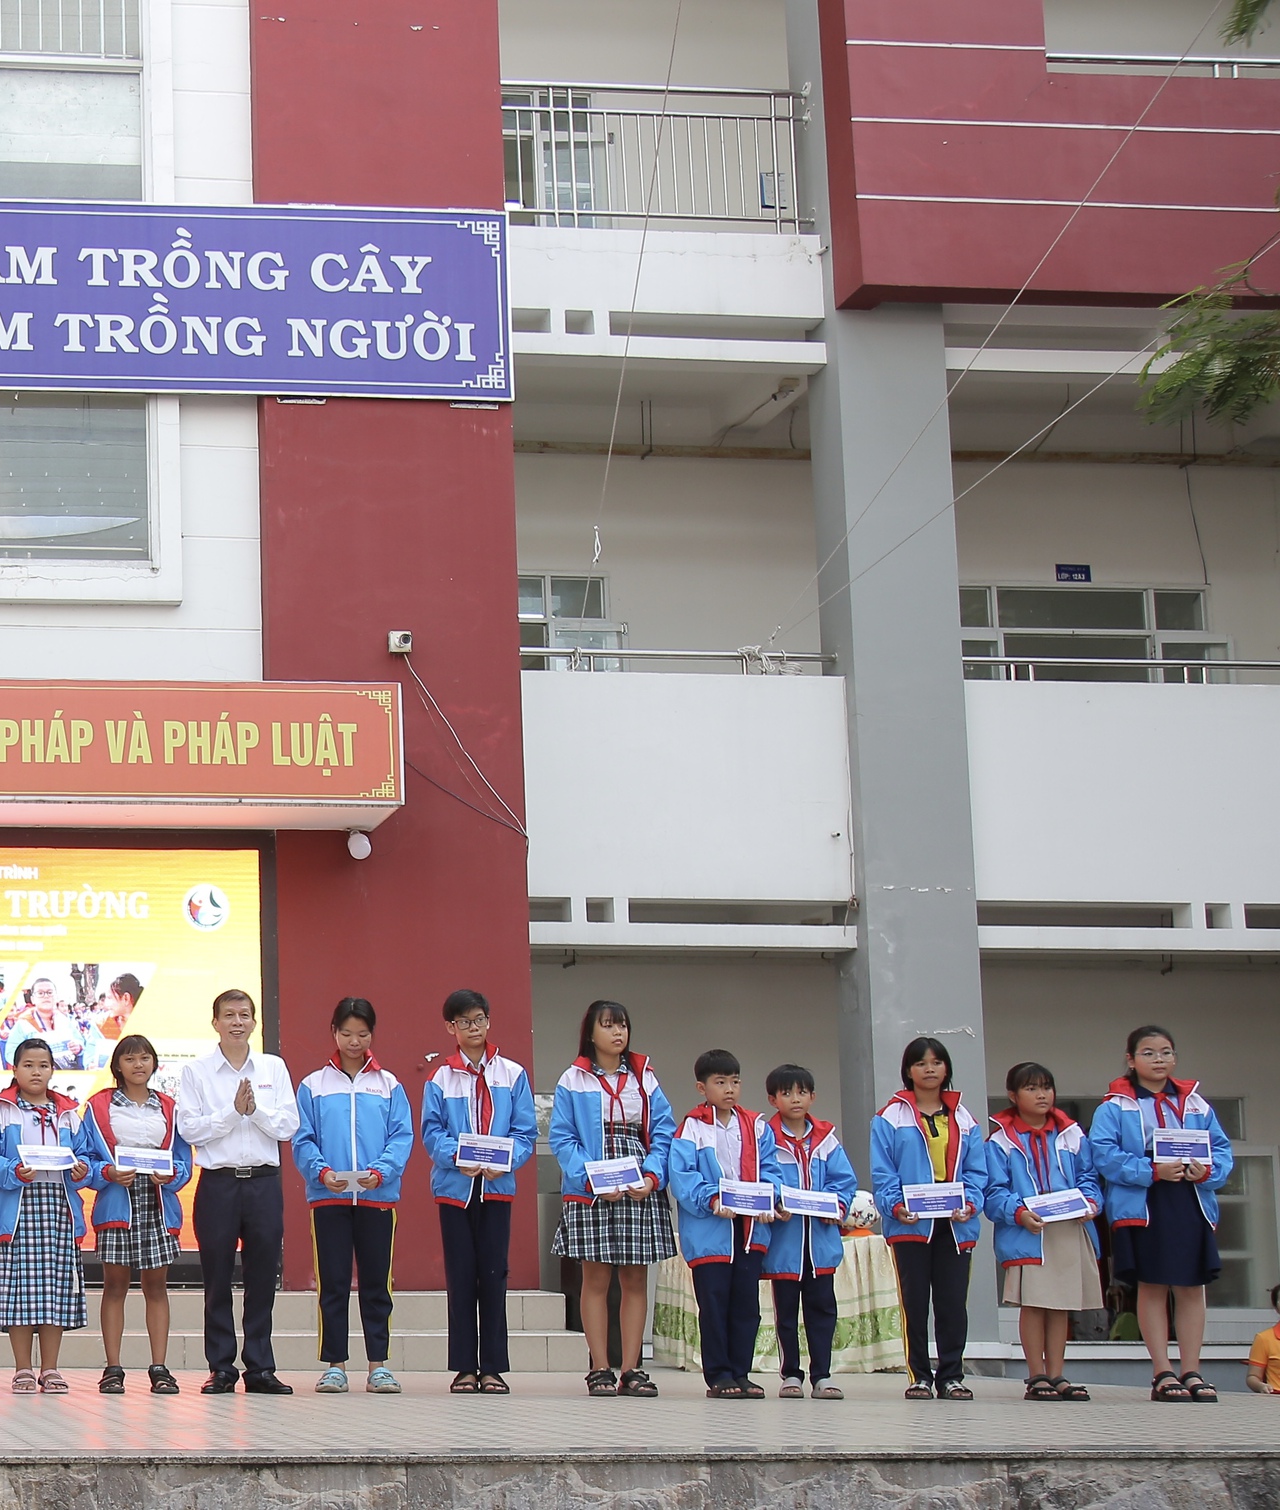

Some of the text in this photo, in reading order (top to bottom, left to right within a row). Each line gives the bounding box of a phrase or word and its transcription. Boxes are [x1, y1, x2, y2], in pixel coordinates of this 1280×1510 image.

[77, 226, 291, 292] TRỒNG
[310, 243, 433, 295] CÂY
[54, 292, 268, 358] TRỒNG
[286, 309, 477, 362] NGƯỜI
[104, 710, 153, 765] VÀ
[163, 711, 260, 766] PHÁP
[271, 713, 358, 777] LUẬT
[4, 883, 150, 920] TRƯỜNG
